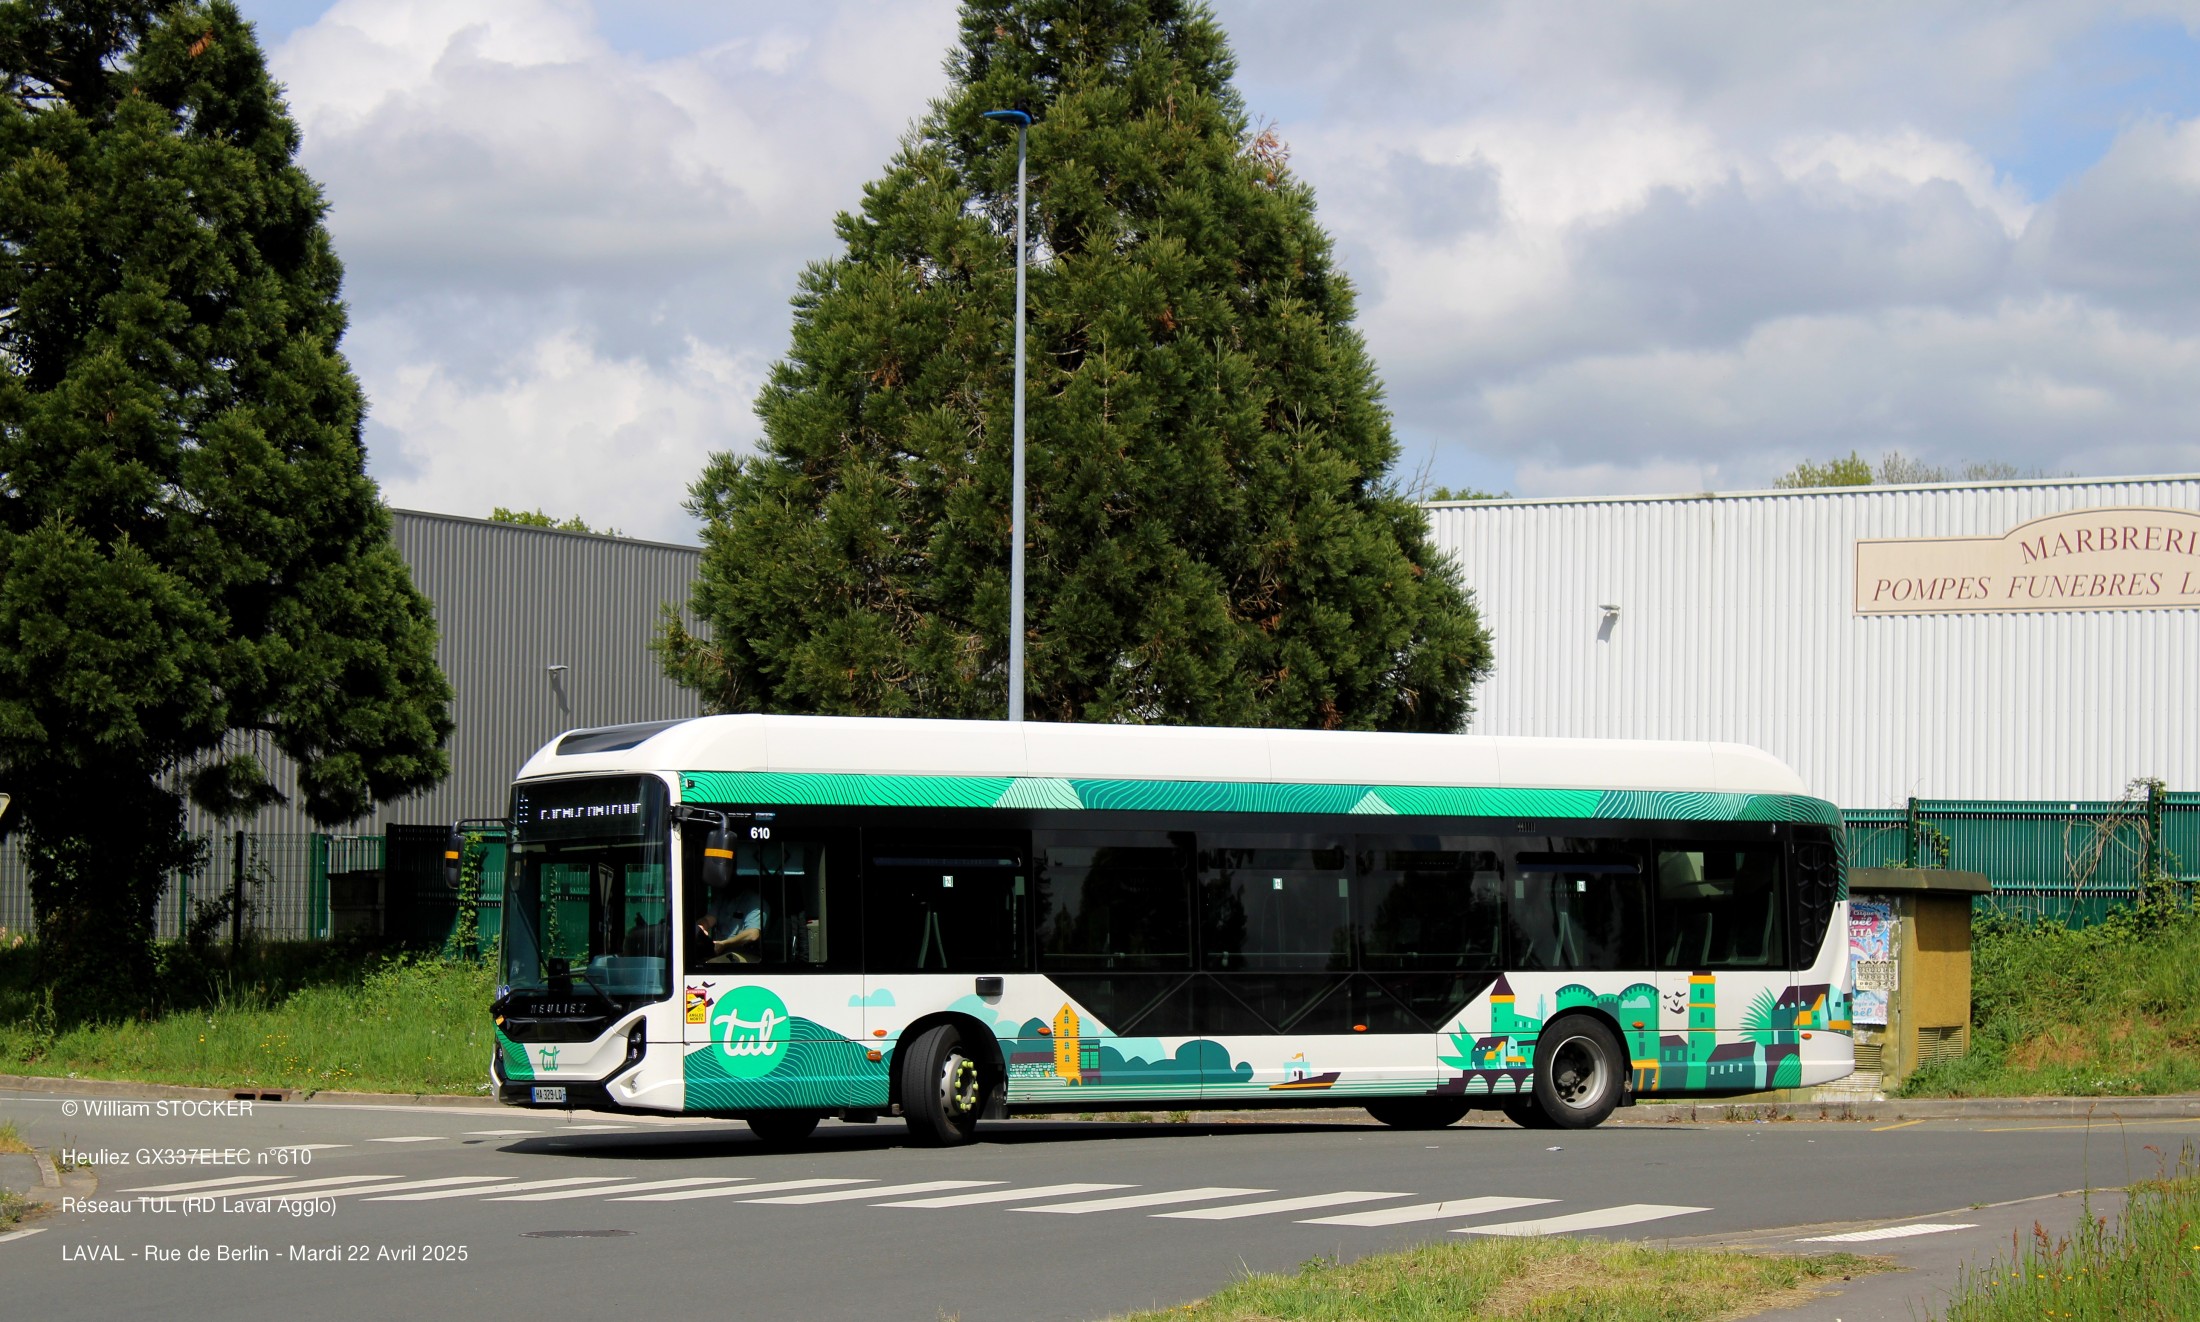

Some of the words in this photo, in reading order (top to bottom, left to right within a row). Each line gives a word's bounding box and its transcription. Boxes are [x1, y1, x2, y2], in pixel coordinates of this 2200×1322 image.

[2020, 526, 2200, 566] MARBRERI
[1872, 576, 1991, 603] POMPES
[2007, 572, 2163, 600] FUNEBRES
[2178, 571, 2200, 595] L
[750, 826, 771, 840] 610
[530, 1003, 587, 1014] HEULIEZ
